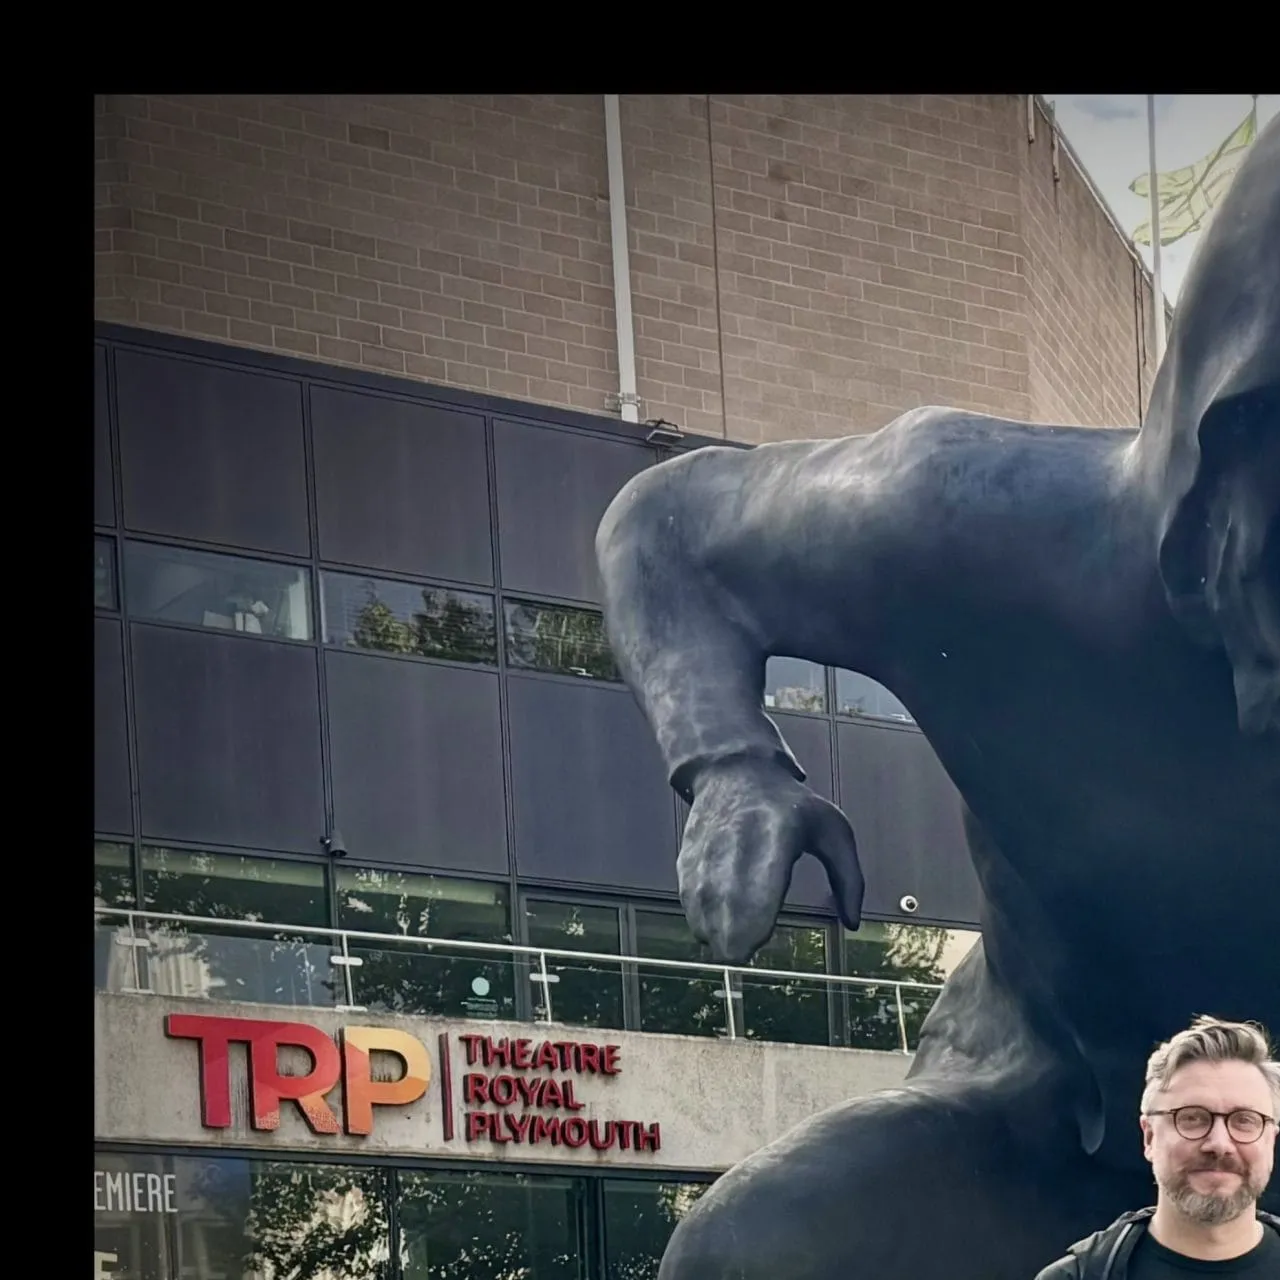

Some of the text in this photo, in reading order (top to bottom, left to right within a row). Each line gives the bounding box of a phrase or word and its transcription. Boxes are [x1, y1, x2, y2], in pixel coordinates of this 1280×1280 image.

[166, 1013, 431, 1136] TRP
[459, 1034, 622, 1075] THEATRE
[463, 1073, 586, 1111] ROYAL
[465, 1111, 661, 1150] PLYMOUTH
[94, 1171, 178, 1212] EMIERE
